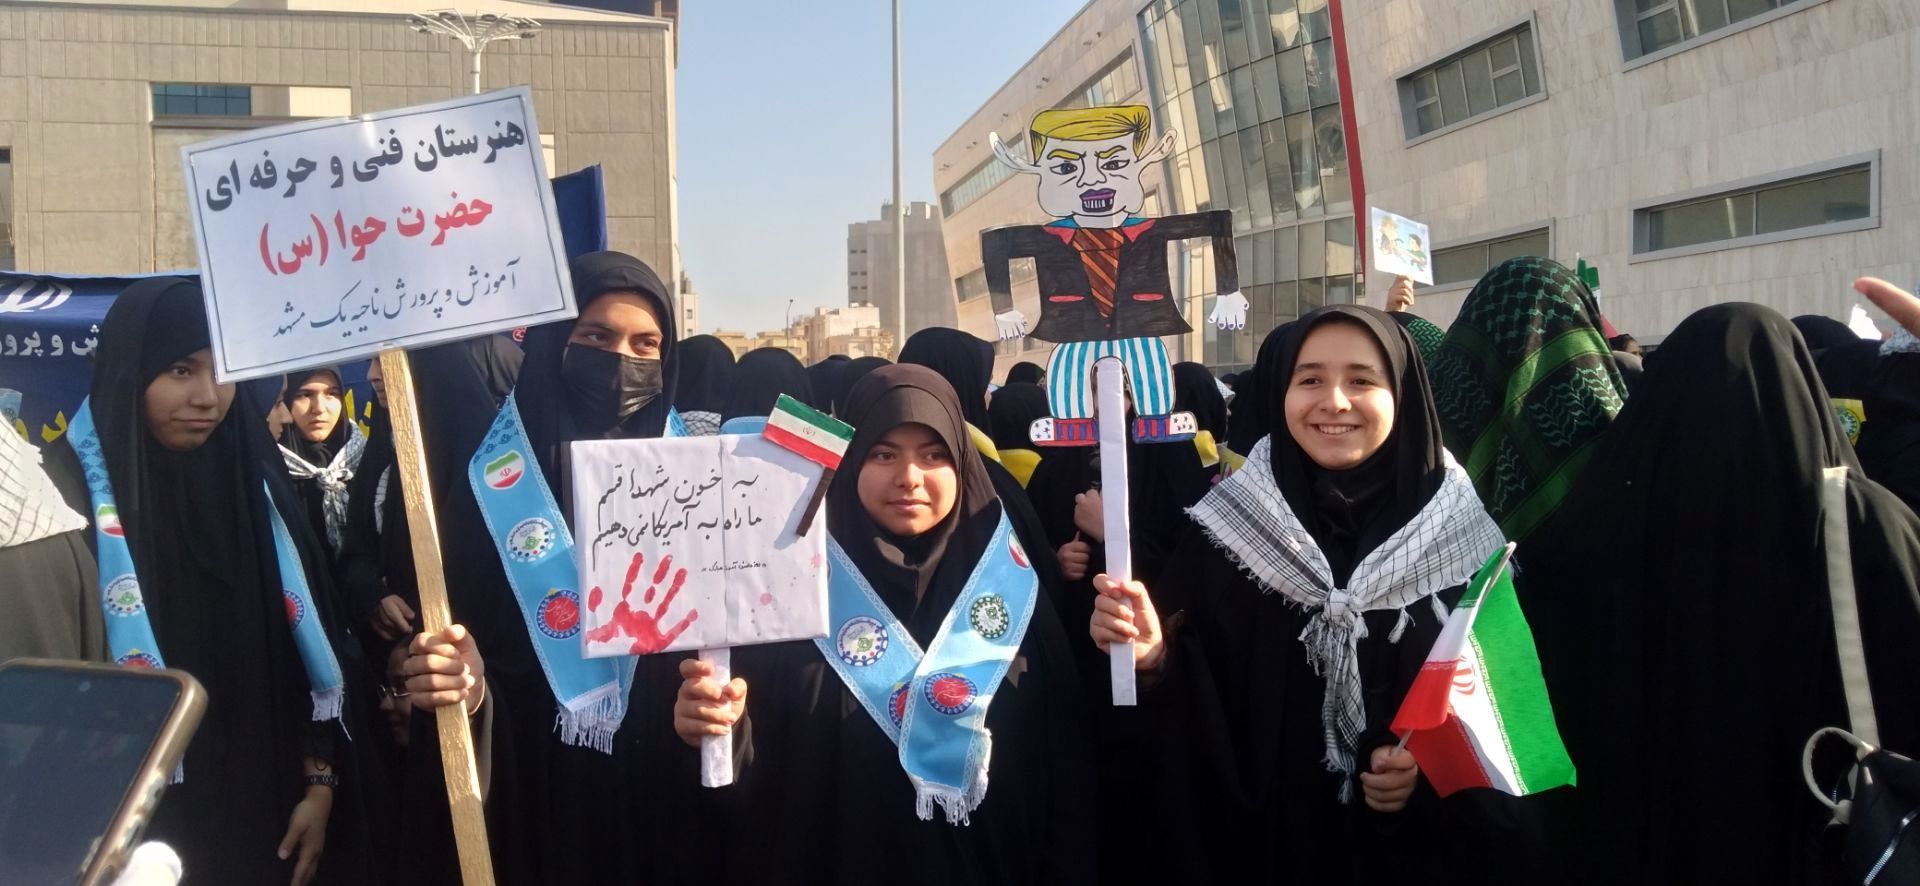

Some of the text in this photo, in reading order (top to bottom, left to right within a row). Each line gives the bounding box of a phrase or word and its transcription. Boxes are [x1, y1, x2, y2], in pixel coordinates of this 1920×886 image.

[206, 120, 525, 212] هنرستان فنی و حرفه ای
[260, 191, 493, 276] حضرت حوا (س)
[272, 256, 520, 338] آموزش و پرورش ناحیه یک مشهد
[0, 331, 44, 357] پرو
[50, 333, 64, 356] و
[598, 463, 759, 533] به خون شهدا قسم
[748, 505, 763, 526] ما
[652, 498, 701, 546] آمریکا
[697, 517, 719, 540] به
[723, 507, 742, 530] راه
